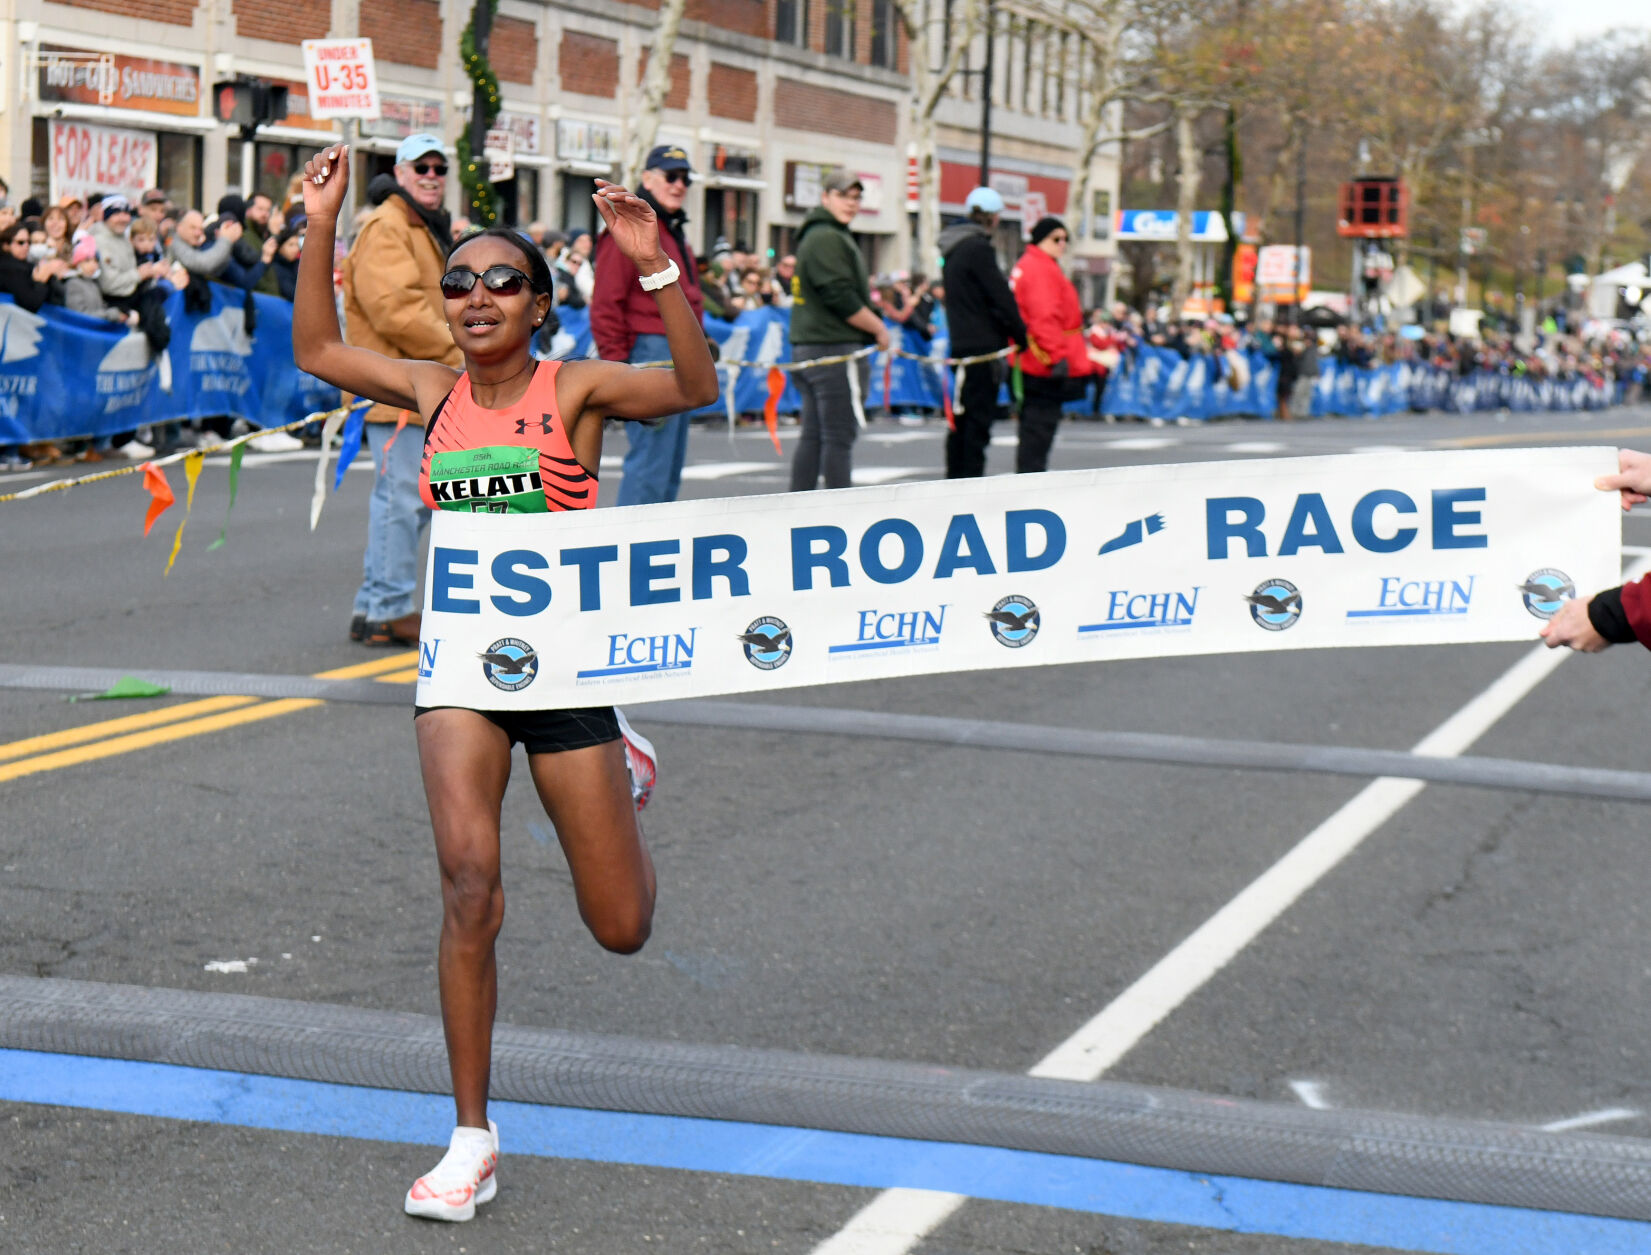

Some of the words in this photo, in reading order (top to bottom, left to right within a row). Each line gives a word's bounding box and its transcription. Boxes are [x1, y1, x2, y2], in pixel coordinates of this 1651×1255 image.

[318, 46, 359, 60] UNDER
[315, 64, 368, 90] U-35
[317, 94, 371, 108] MINUTES
[54, 123, 91, 181] FOR
[432, 464, 486, 477] MANCHESTER
[488, 461, 511, 471] ROAD
[430, 472, 542, 501] KELATI
[432, 535, 750, 616] ESTER
[792, 510, 1067, 591] ROAD
[1207, 488, 1488, 560] RACE
